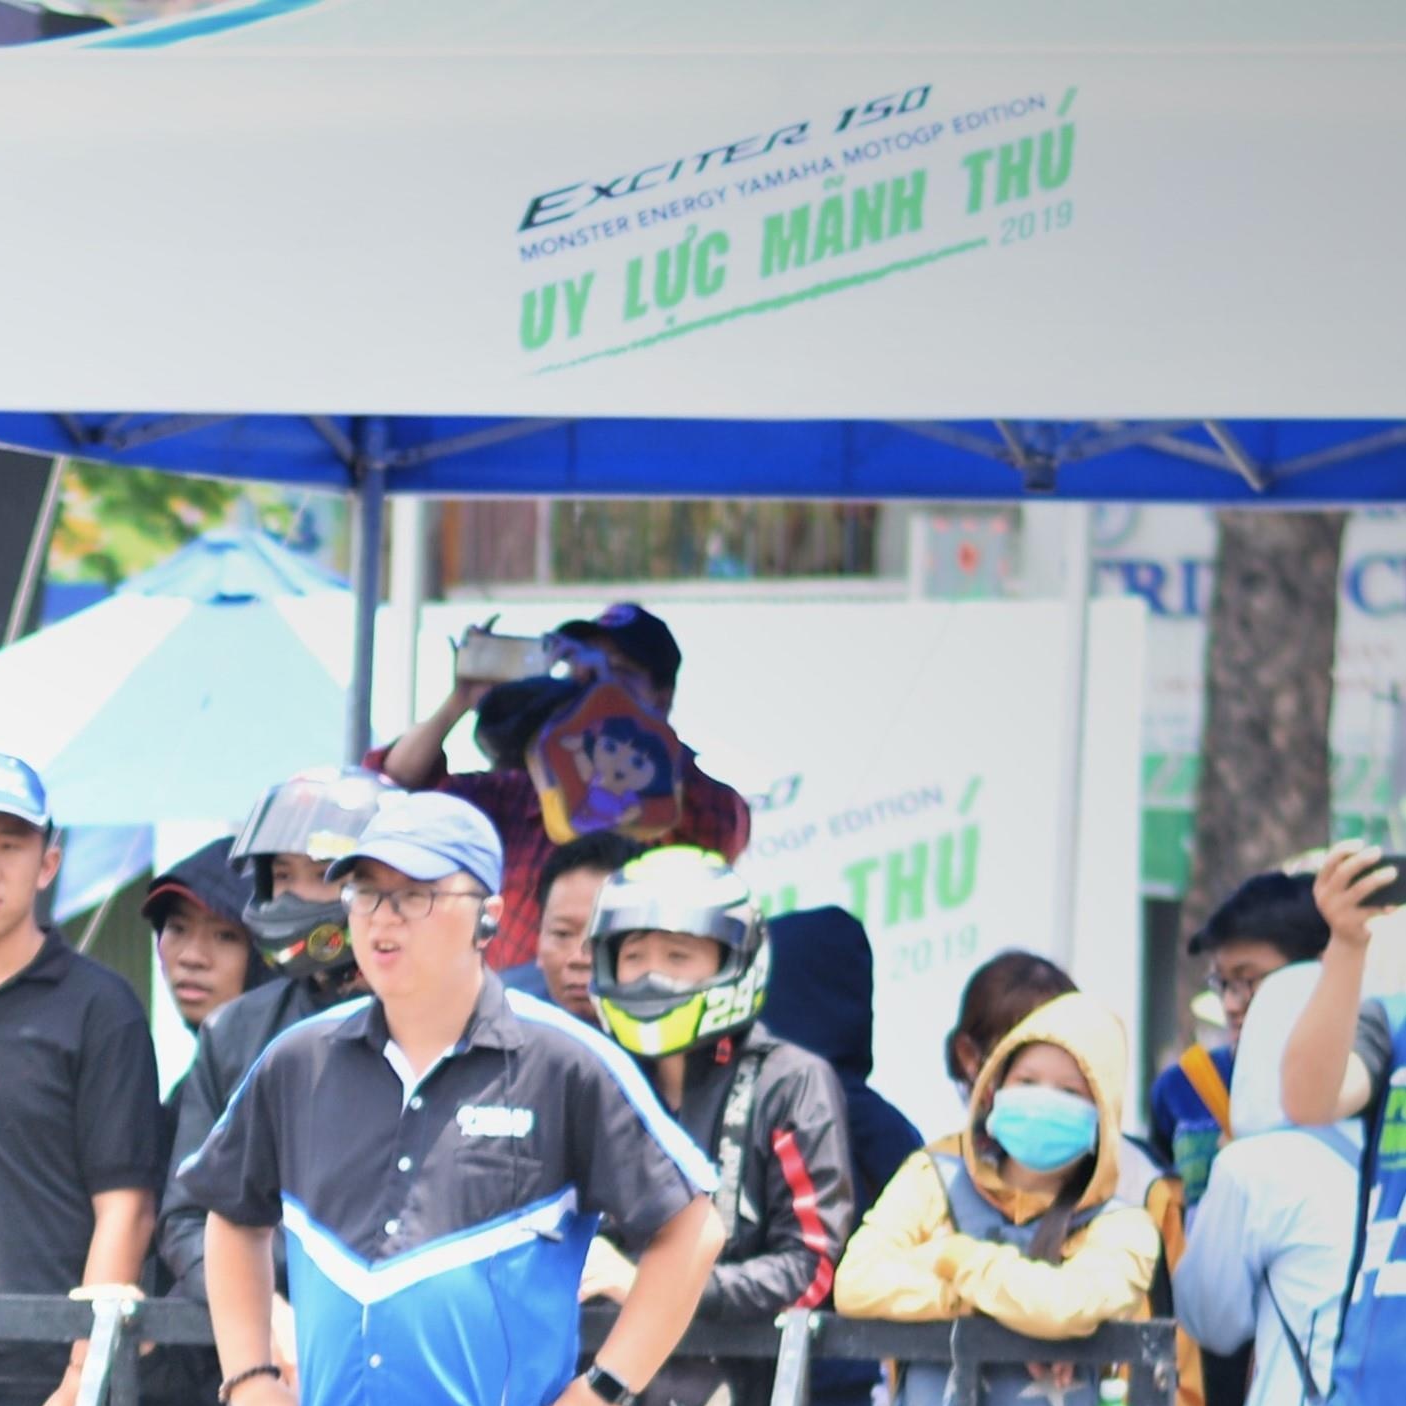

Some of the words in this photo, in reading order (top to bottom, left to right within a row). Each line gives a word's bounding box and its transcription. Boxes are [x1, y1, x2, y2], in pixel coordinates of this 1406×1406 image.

[516, 122, 810, 233] EXCITER
[834, 84, 933, 133] 150
[520, 216, 630, 262] MONSTER
[639, 185, 728, 229] ENERGY
[734, 154, 835, 200] YAMAHA
[843, 122, 945, 168] MOTOGP
[952, 93, 1047, 135] EDITION
[519, 270, 595, 351] UY
[760, 169, 928, 277] MÃNH
[961, 86, 1078, 214] THÚ
[1000, 199, 1074, 246] 2019
[829, 786, 943, 836] EDITION
[892, 924, 979, 981] 2019
